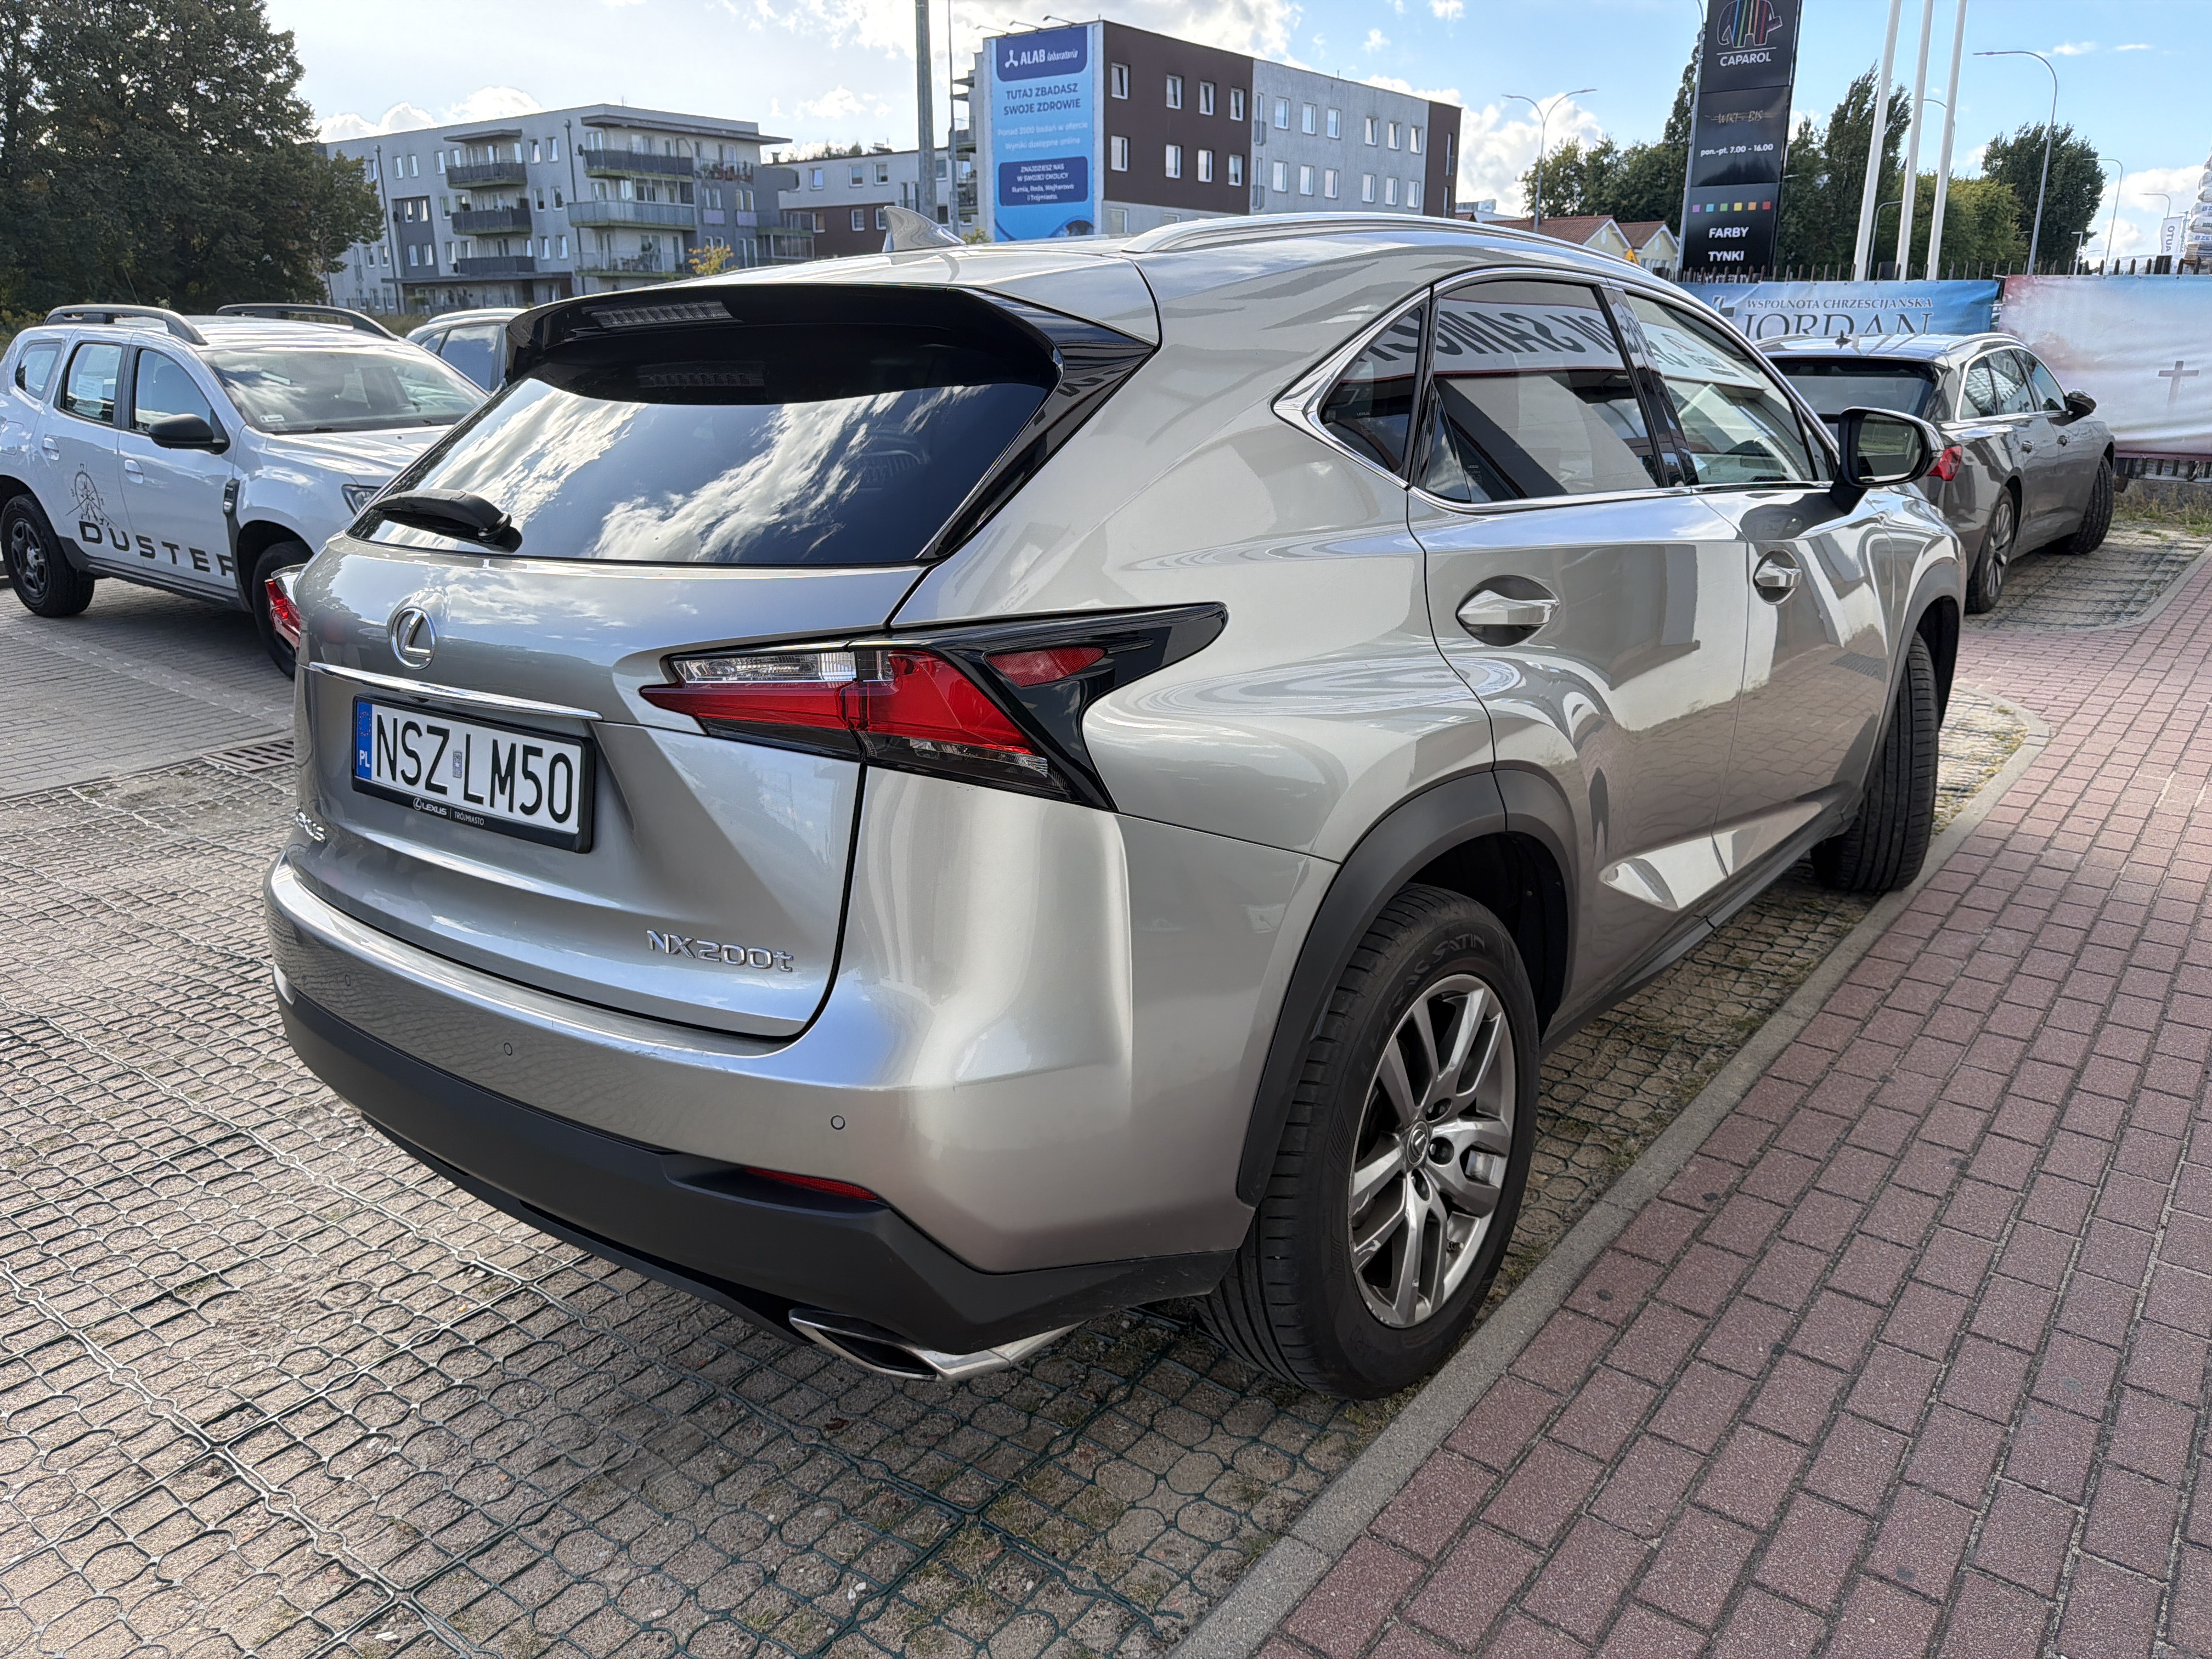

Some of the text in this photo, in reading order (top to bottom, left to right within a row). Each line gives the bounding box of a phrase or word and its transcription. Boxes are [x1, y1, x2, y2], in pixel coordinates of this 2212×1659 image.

[1020, 49, 1046, 65] ALAB
[1720, 52, 1771, 66] CAPAROL
[1006, 83, 1078, 100] TUTAJ ZBADASZ
[1003, 98, 1081, 116] SWOJE ZDROWIE
[1701, 147, 1728, 157] pon.-pt.
[1730, 145, 1746, 154] 7.00
[1753, 143, 1774, 151] 16.00
[1708, 227, 1750, 239] FARBY
[1708, 250, 1745, 262] TYNKI
[359, 749, 370, 768] PL
[376, 713, 573, 823] NSZ LM50
[422, 802, 484, 826] LEXUS TRÓJMIASTO
[646, 929, 794, 973] NX200t
